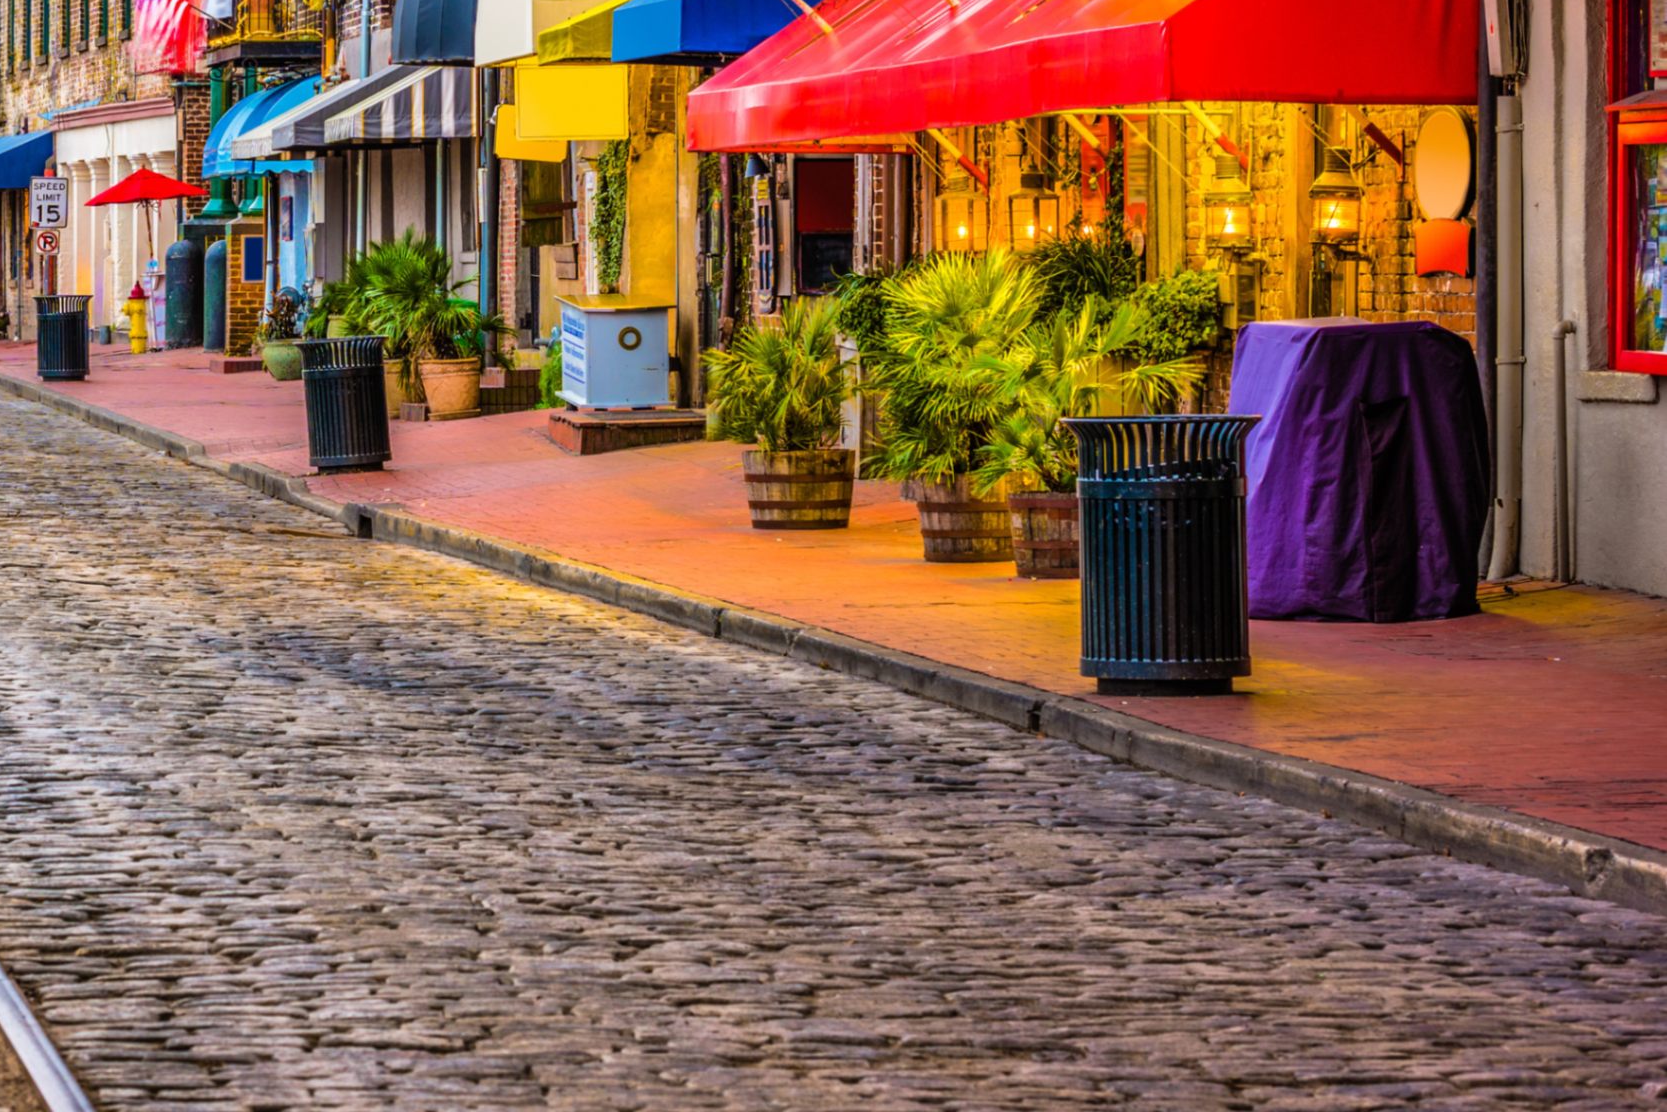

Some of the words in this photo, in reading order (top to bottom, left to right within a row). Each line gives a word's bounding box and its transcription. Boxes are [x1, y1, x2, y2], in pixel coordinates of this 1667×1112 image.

[33, 182, 66, 191] SPEED
[36, 193, 61, 201] LIMIT
[36, 204, 60, 224] 15
